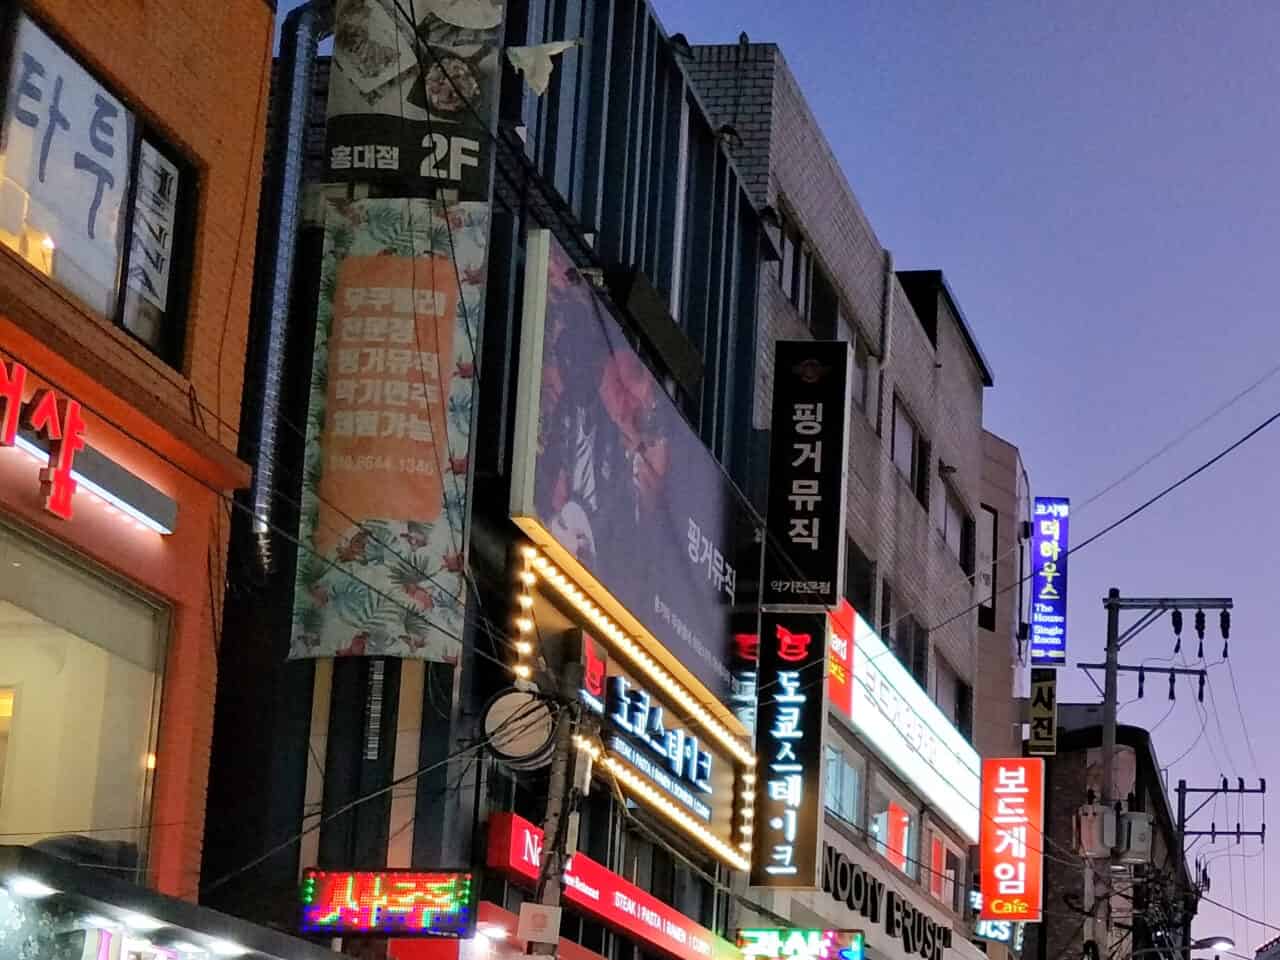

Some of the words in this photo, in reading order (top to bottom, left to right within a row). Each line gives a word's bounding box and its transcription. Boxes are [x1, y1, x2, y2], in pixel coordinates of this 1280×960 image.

[421, 134, 479, 180] 2F
[788, 403, 824, 550] 핑거뮤직
[1039, 519, 1061, 599] 더하우스
[1034, 603, 1054, 613] The
[1034, 613, 1065, 623] House
[1031, 686, 1053, 741] 사진
[993, 766, 1029, 895] 보드게임
[991, 899, 1029, 914] Cafe
